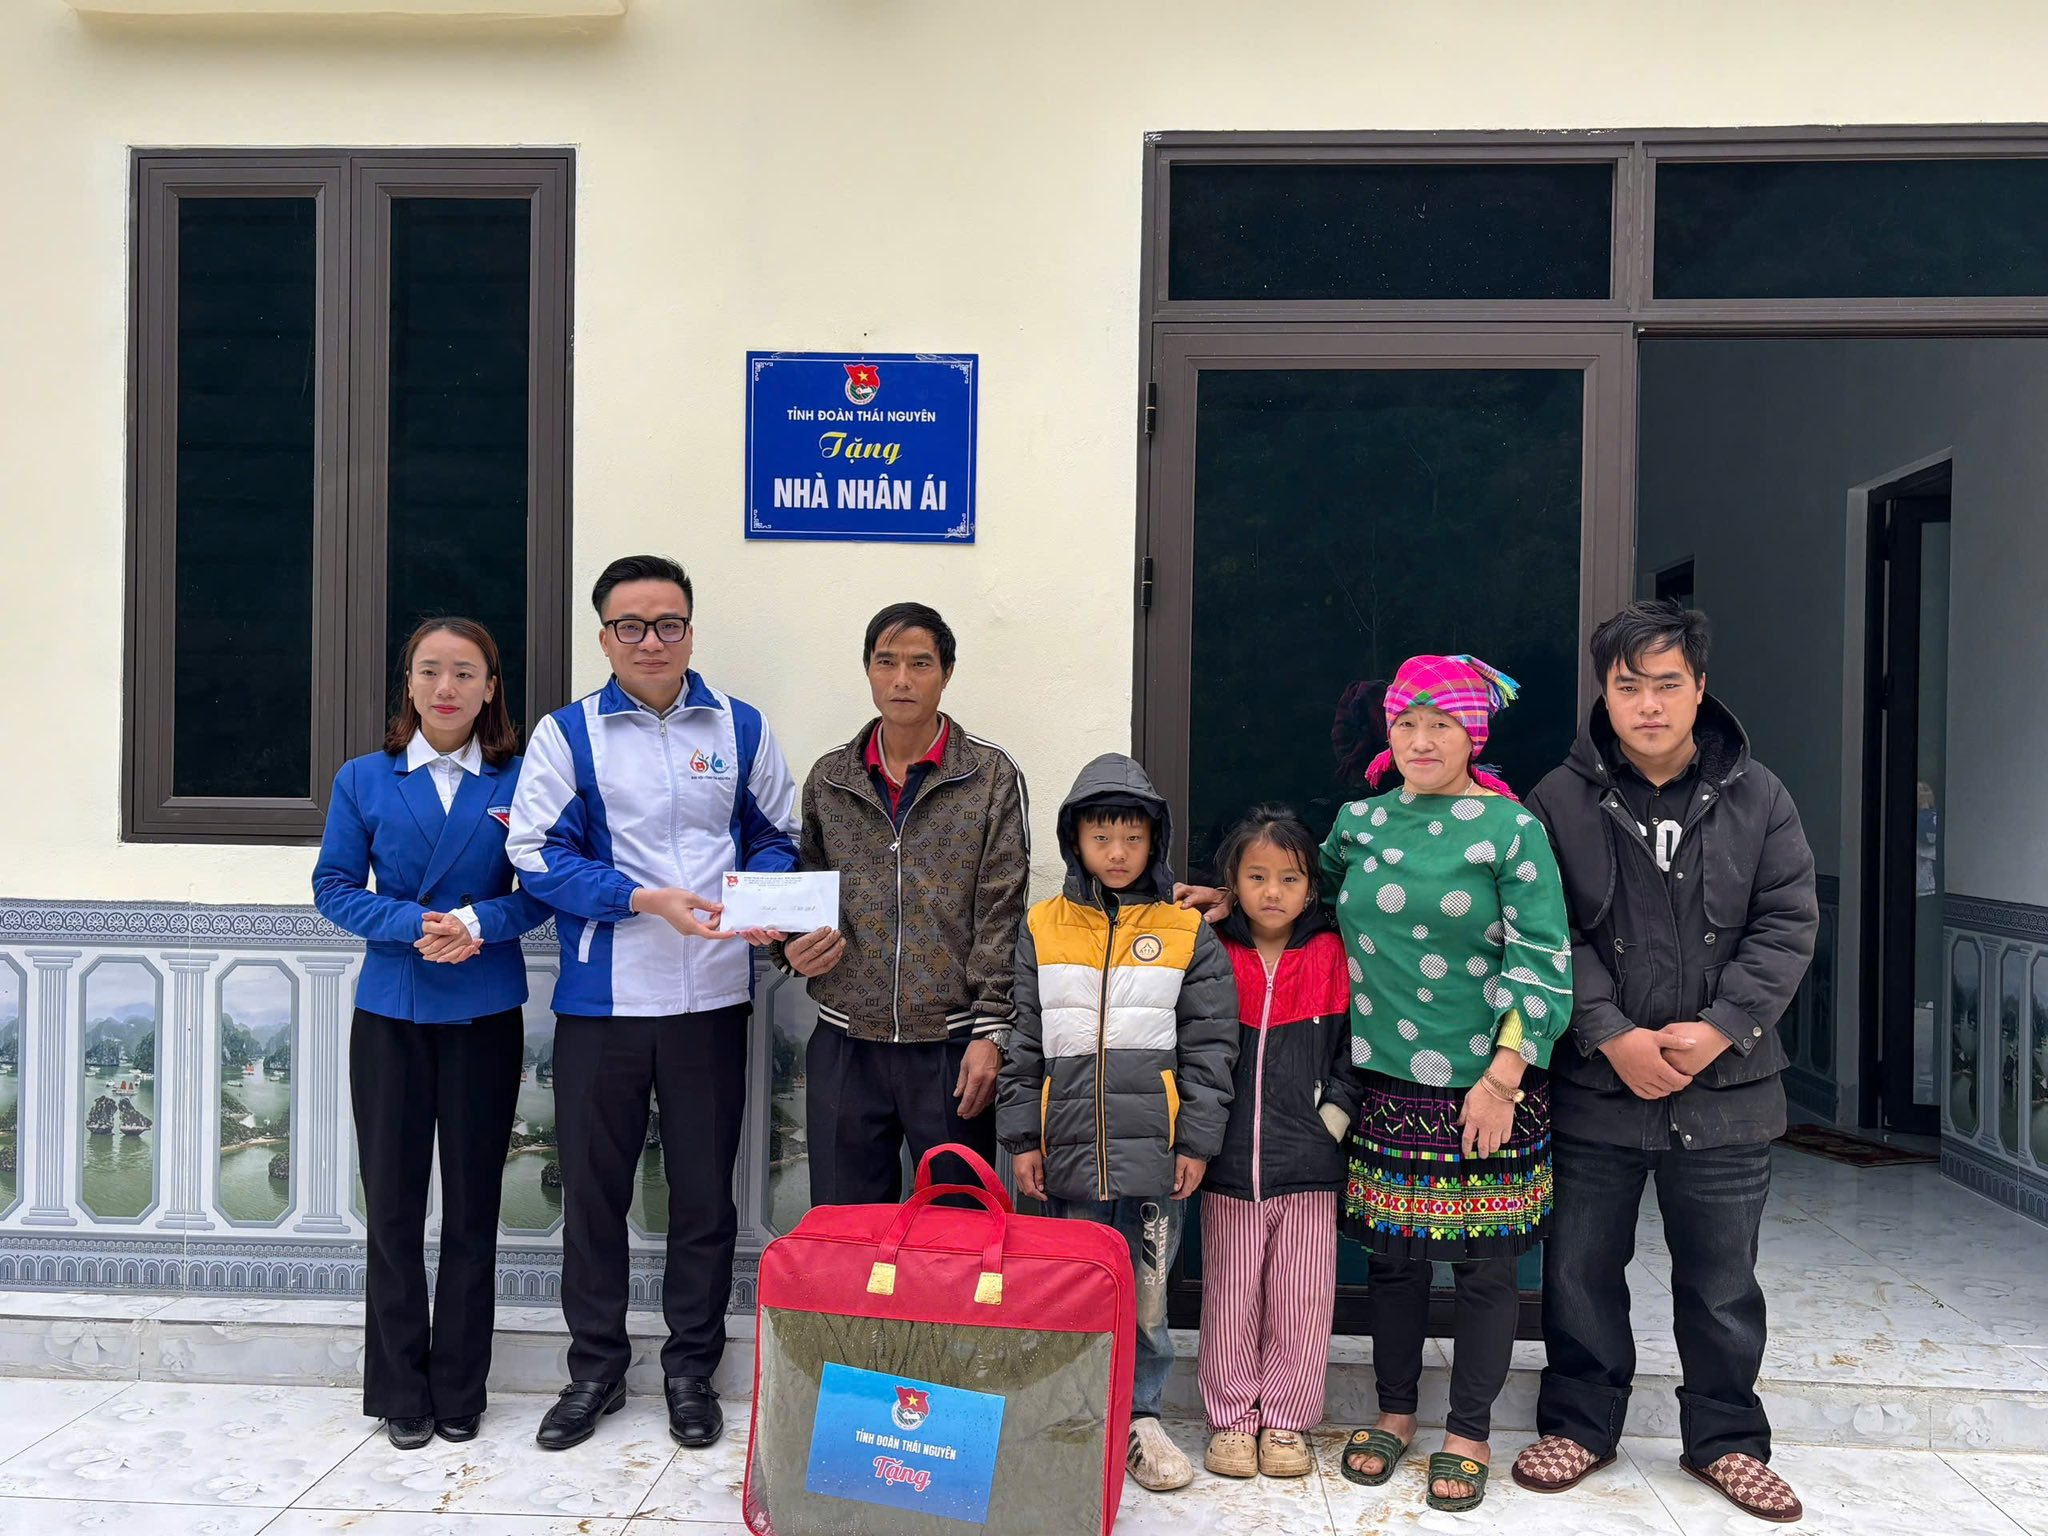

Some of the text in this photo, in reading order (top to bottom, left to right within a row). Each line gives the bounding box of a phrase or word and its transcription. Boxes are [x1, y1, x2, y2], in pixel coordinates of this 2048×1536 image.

[787, 406, 936, 423] TỈNH ĐOÀN THÁI NGUYÊN
[819, 431, 902, 465] Tặng
[774, 472, 946, 511] NHÀ NHÂN ÁI
[855, 1428, 957, 1461] TỈNH ĐOÀN THÁI NGUYÊN
[872, 1455, 932, 1493] Tặng
